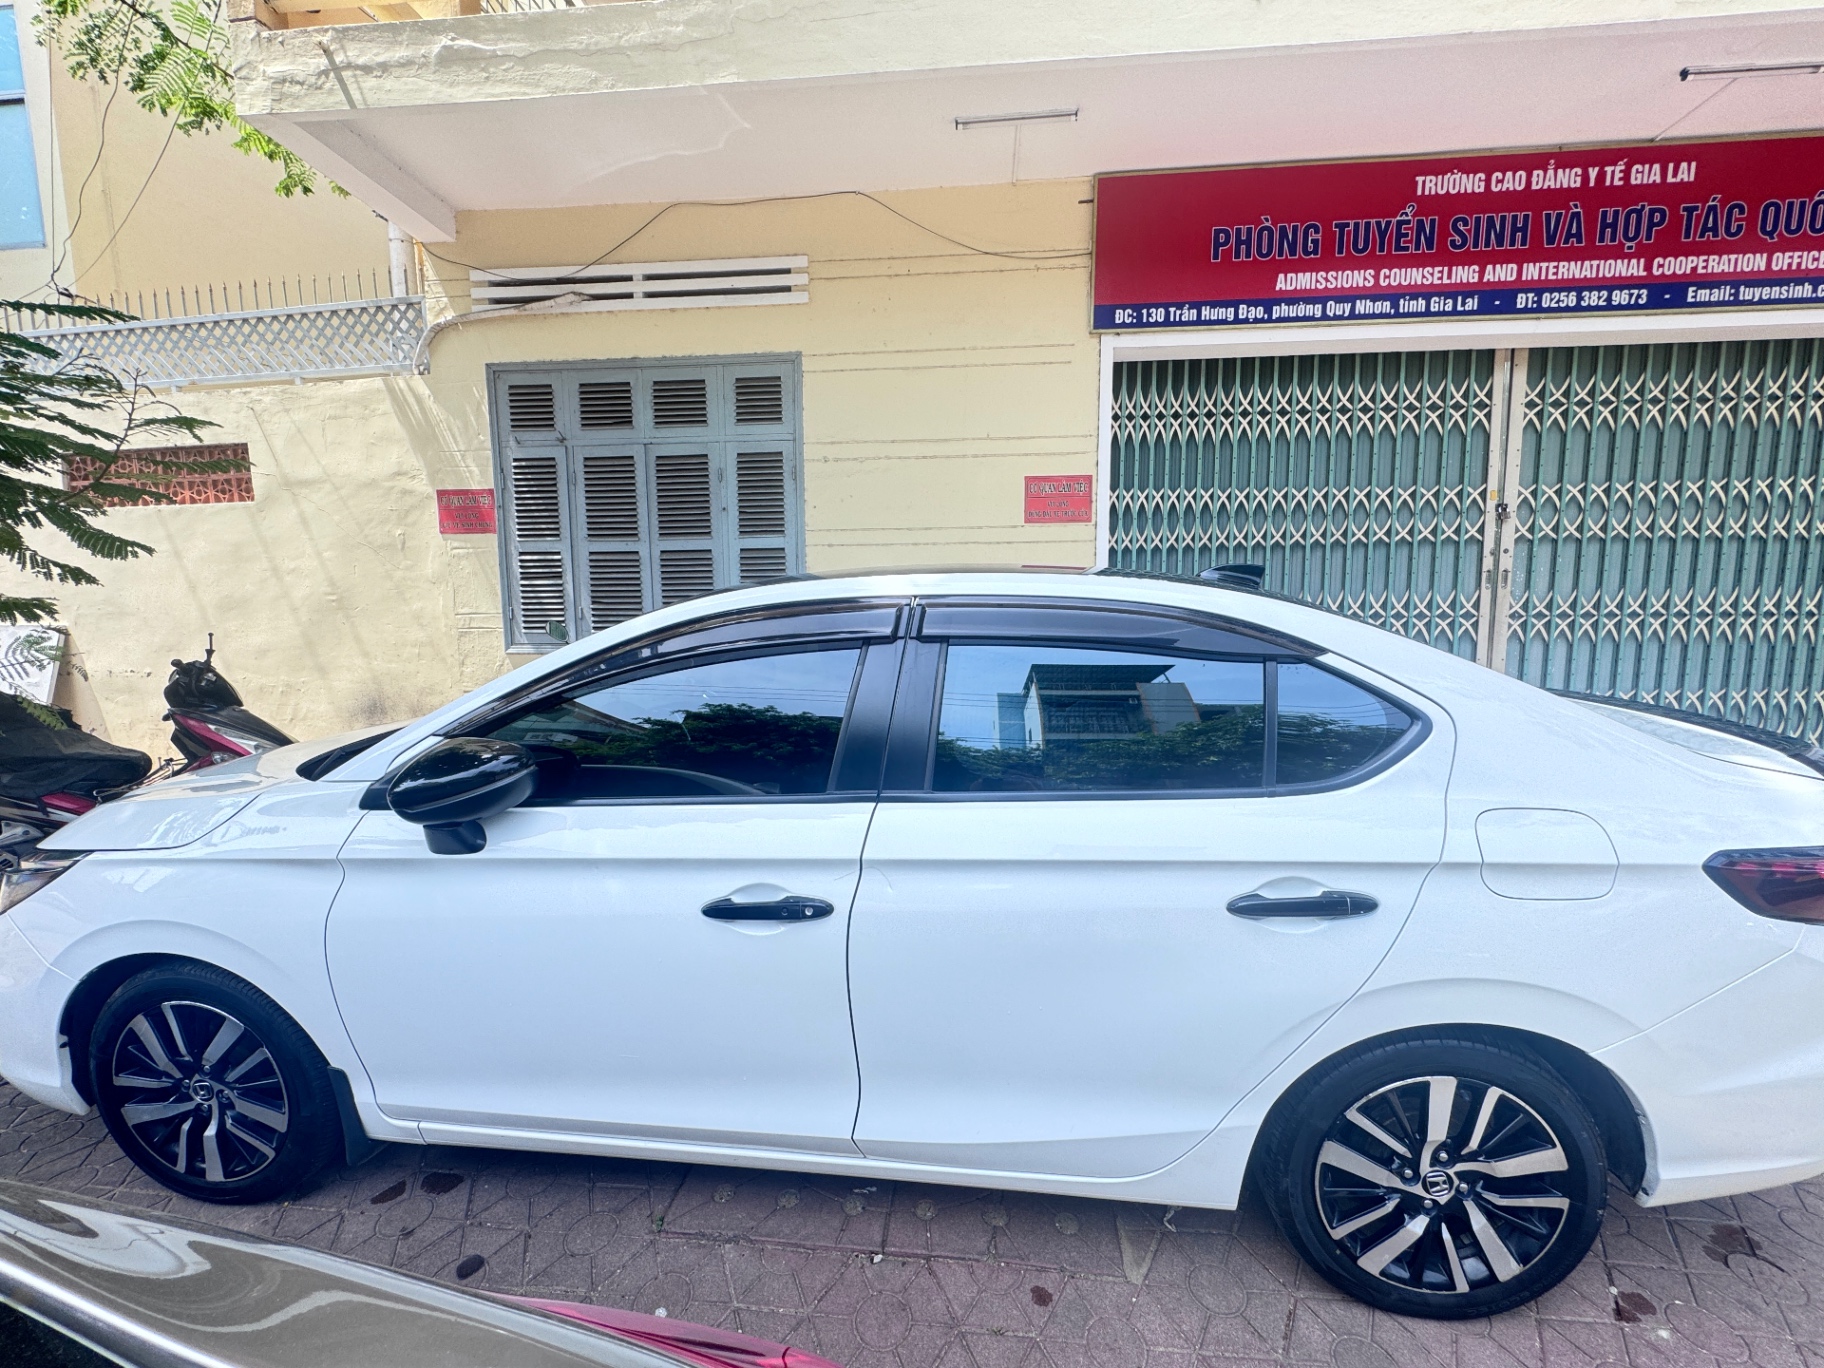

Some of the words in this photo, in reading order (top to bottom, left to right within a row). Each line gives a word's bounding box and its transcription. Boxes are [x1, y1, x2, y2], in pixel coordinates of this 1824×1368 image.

[1415, 168, 1486, 195] TRƯỜNG
[1490, 170, 1526, 192] CAO
[1531, 159, 1582, 190] ĐẲNG
[1588, 166, 1600, 187] Y
[1603, 158, 1629, 186] TẾ
[1630, 162, 1662, 185] GIA
[1666, 161, 1697, 183] LAI
[1210, 215, 1322, 263] PHÒNG
[1332, 203, 1439, 257] TUYỂN
[1448, 211, 1532, 252] SINH
[1542, 202, 1585, 248] VÀ
[1596, 202, 1668, 252] HỢP
[1680, 194, 1748, 242] TÁC
[1275, 269, 1375, 291] ADMISSIONS
[1379, 264, 1479, 286] COUNSELING
[1483, 263, 1518, 283] AND
[1522, 258, 1648, 281] INTERNATIONAL
[1652, 253, 1768, 276] COOPERATION
[1114, 309, 1137, 324] ĐC:
[1141, 307, 1165, 323] 130
[1169, 304, 1197, 322] Trần
[1201, 304, 1235, 321] Hưng
[1238, 304, 1269, 324] Đạo,
[1272, 301, 1322, 320] phường
[1326, 300, 1351, 318] Quy
[1355, 298, 1395, 316] Nhơn,
[1398, 294, 1426, 313] tỉnh
[1430, 294, 1452, 311] Gia
[1457, 294, 1479, 311] Lai
[1516, 293, 1538, 309] ĐT:
[1542, 290, 1577, 307] 0256
[1581, 290, 1608, 306] 382
[1611, 288, 1648, 305] 9673
[1687, 286, 1735, 302] Email:
[1058, 479, 1071, 493] LÀM
